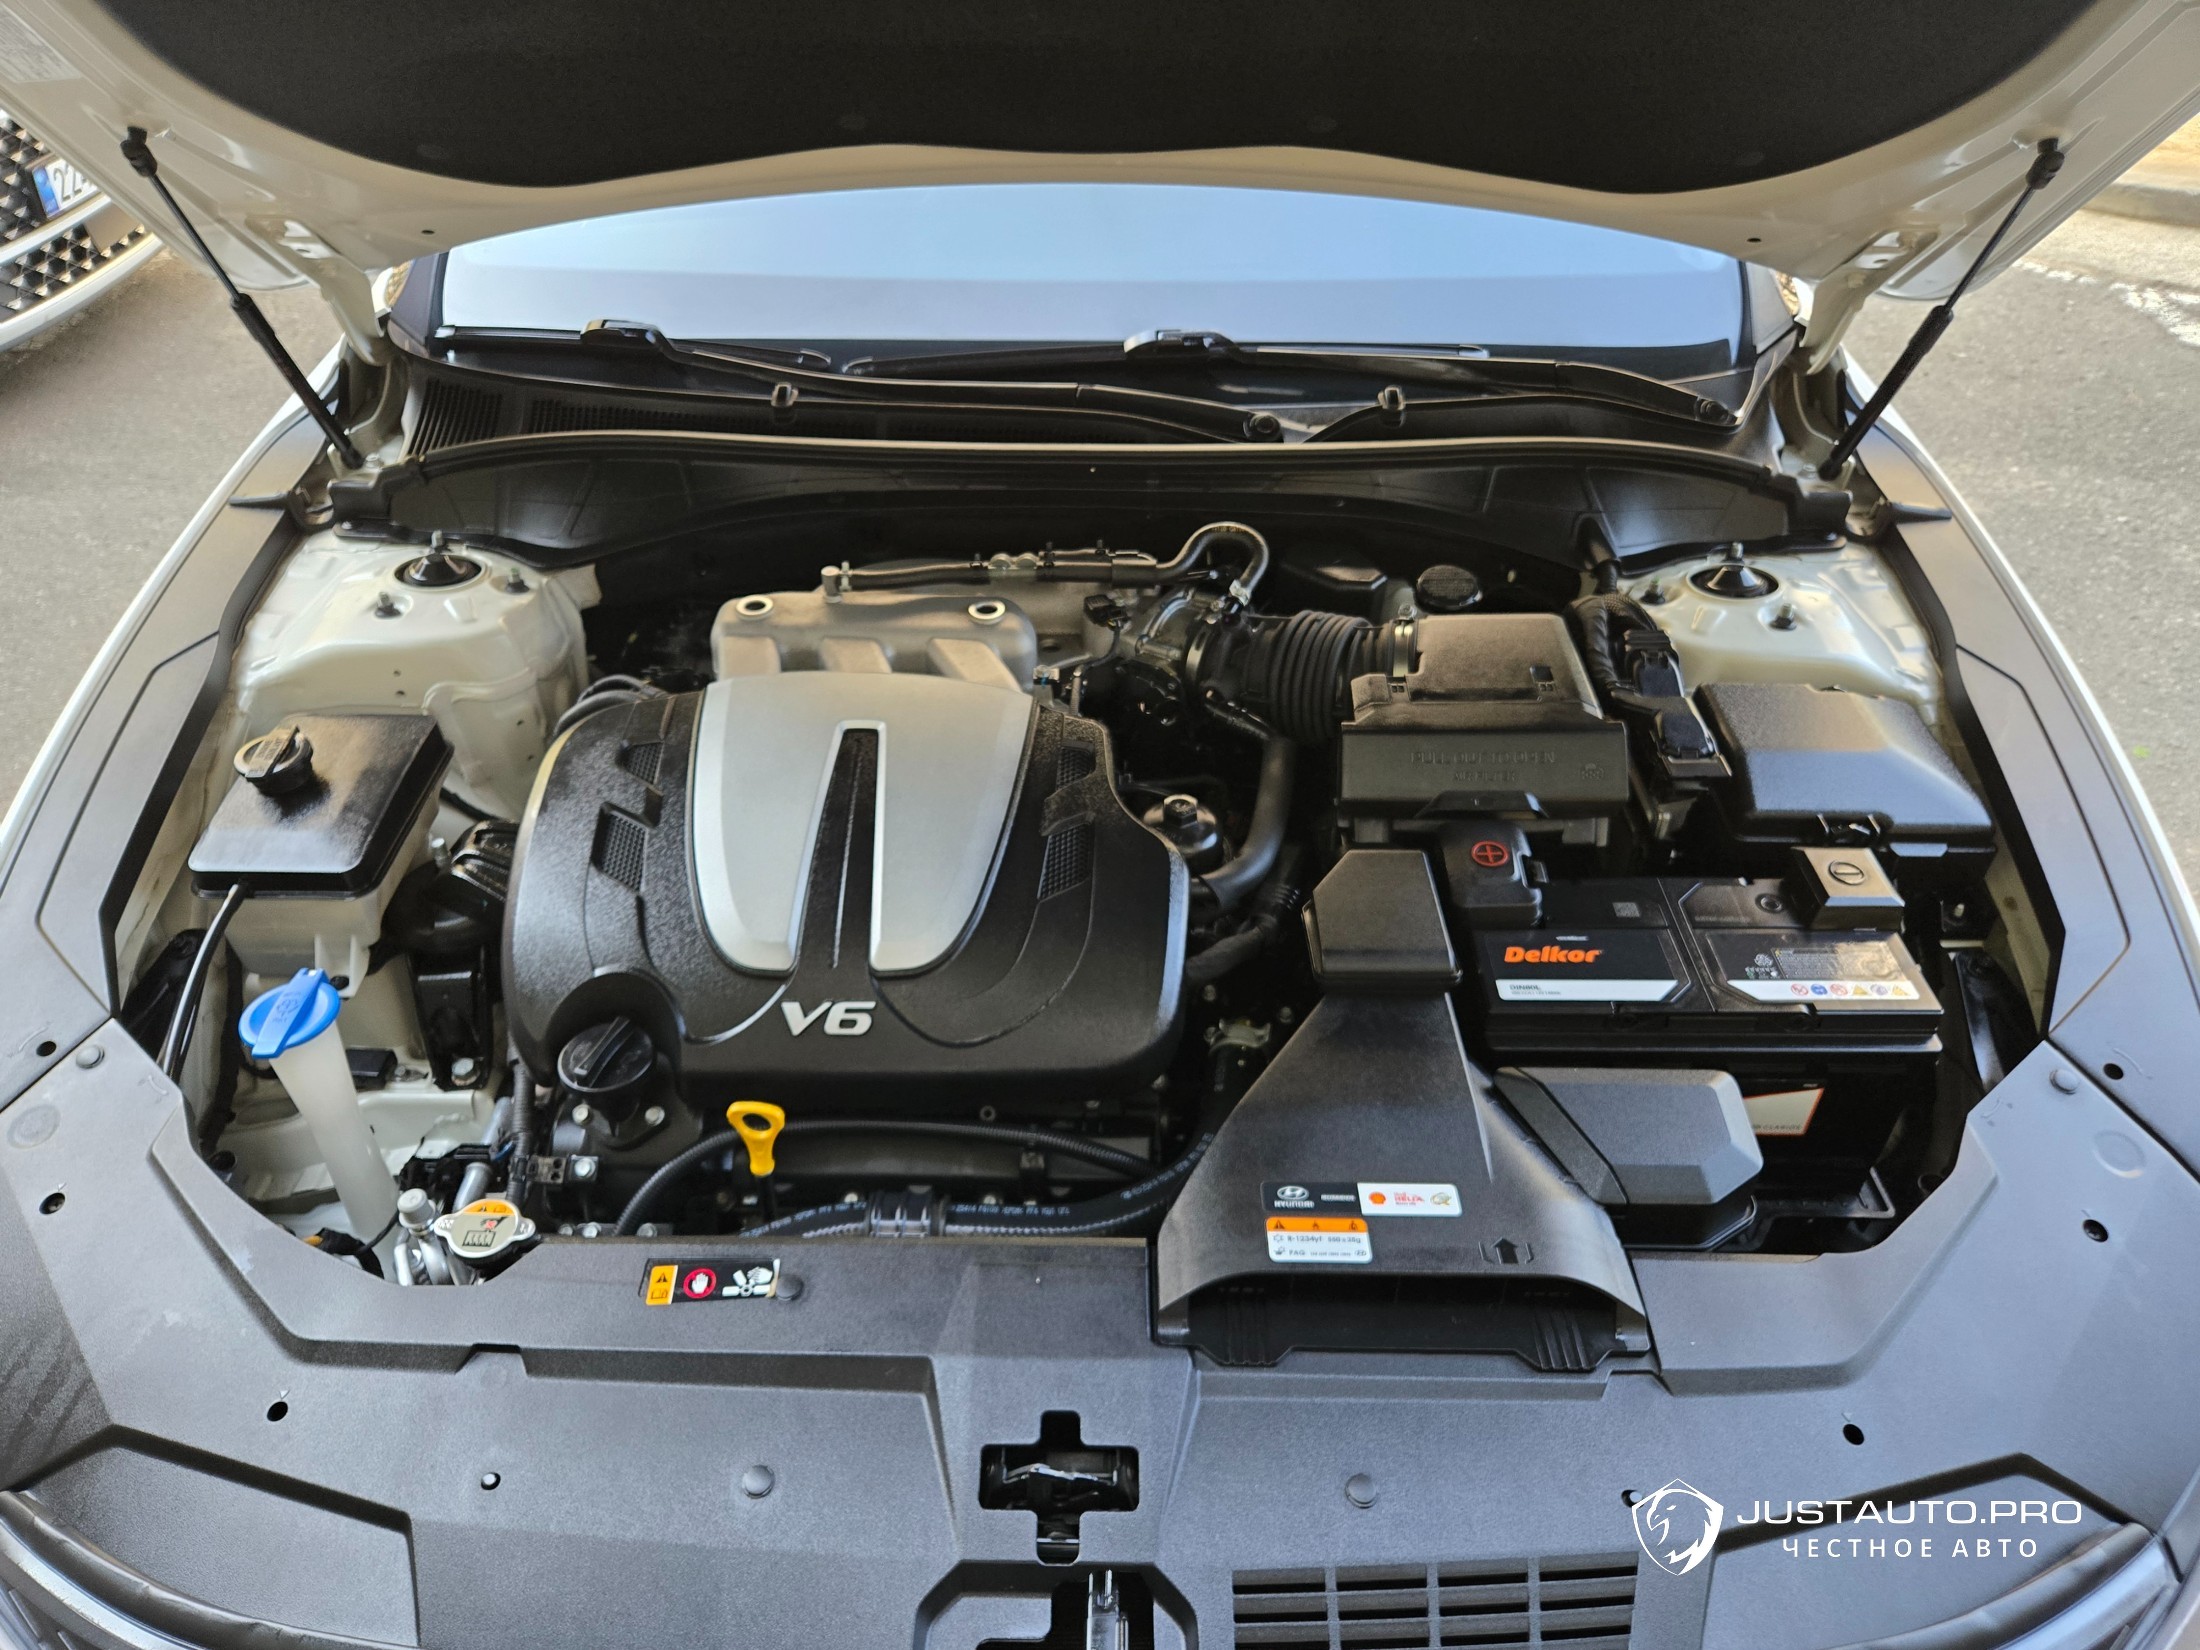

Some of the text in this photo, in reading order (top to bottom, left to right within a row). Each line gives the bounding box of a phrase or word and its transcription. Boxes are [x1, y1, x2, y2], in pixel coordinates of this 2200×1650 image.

[1411, 751, 1556, 764] PULL OUT TO OPEN
[1504, 945, 1600, 963] Delkor
[781, 1001, 876, 1036] V6
[1274, 1200, 1315, 1208] HYUNDAI
